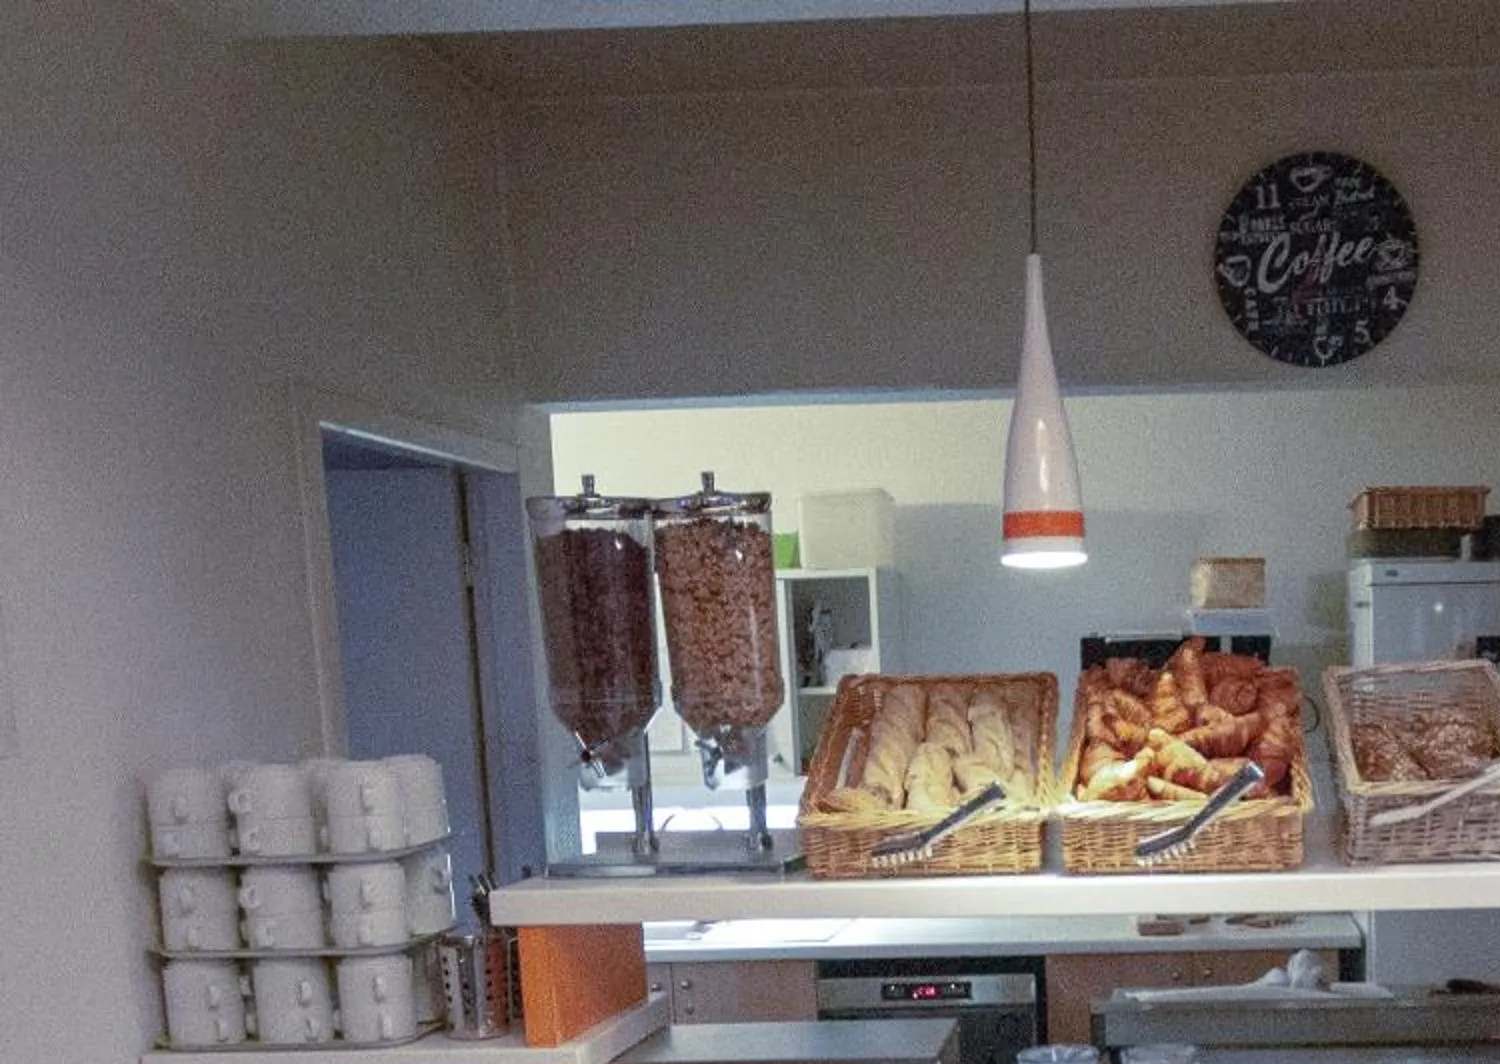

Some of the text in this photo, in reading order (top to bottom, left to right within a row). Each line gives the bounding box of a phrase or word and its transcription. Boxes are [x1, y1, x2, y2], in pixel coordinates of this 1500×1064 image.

[1255, 183, 1281, 210] 11
[1256, 230, 1376, 294] Coffee
[1383, 285, 1400, 310] 4
[1354, 319, 1371, 344] 5
